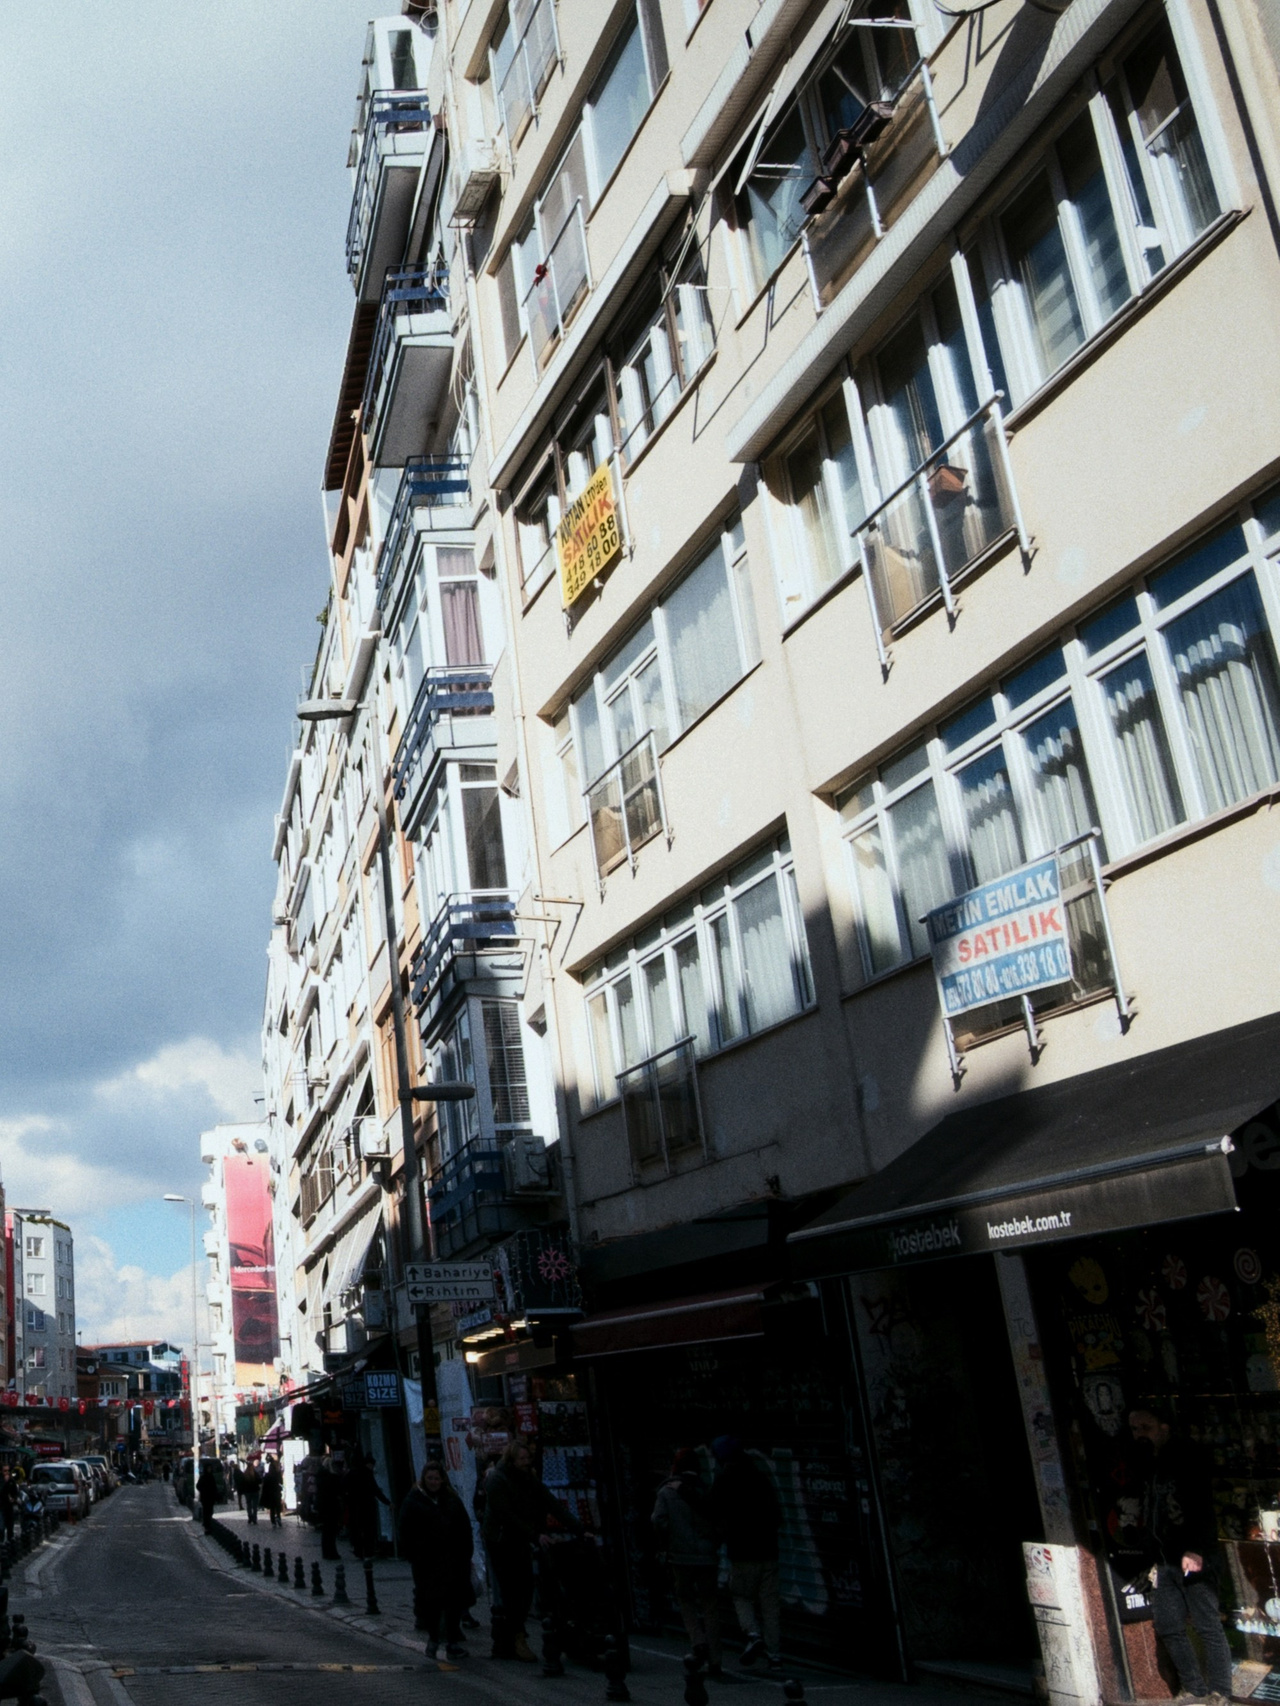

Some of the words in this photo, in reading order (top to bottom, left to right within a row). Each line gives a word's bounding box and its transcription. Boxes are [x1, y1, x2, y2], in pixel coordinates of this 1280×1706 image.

[562, 490, 613, 568] SATILIK
[601, 531, 618, 556] 00
[984, 869, 1058, 917] EMLAK
[957, 906, 1063, 963] SATILIK
[986, 1210, 1072, 1240] kostebek.com.tr
[423, 1266, 490, 1280] Bahariye
[366, 1372, 398, 1388] KOZMO
[345, 1392, 365, 1403] SIZ
[368, 1387, 399, 1399] SIZE
